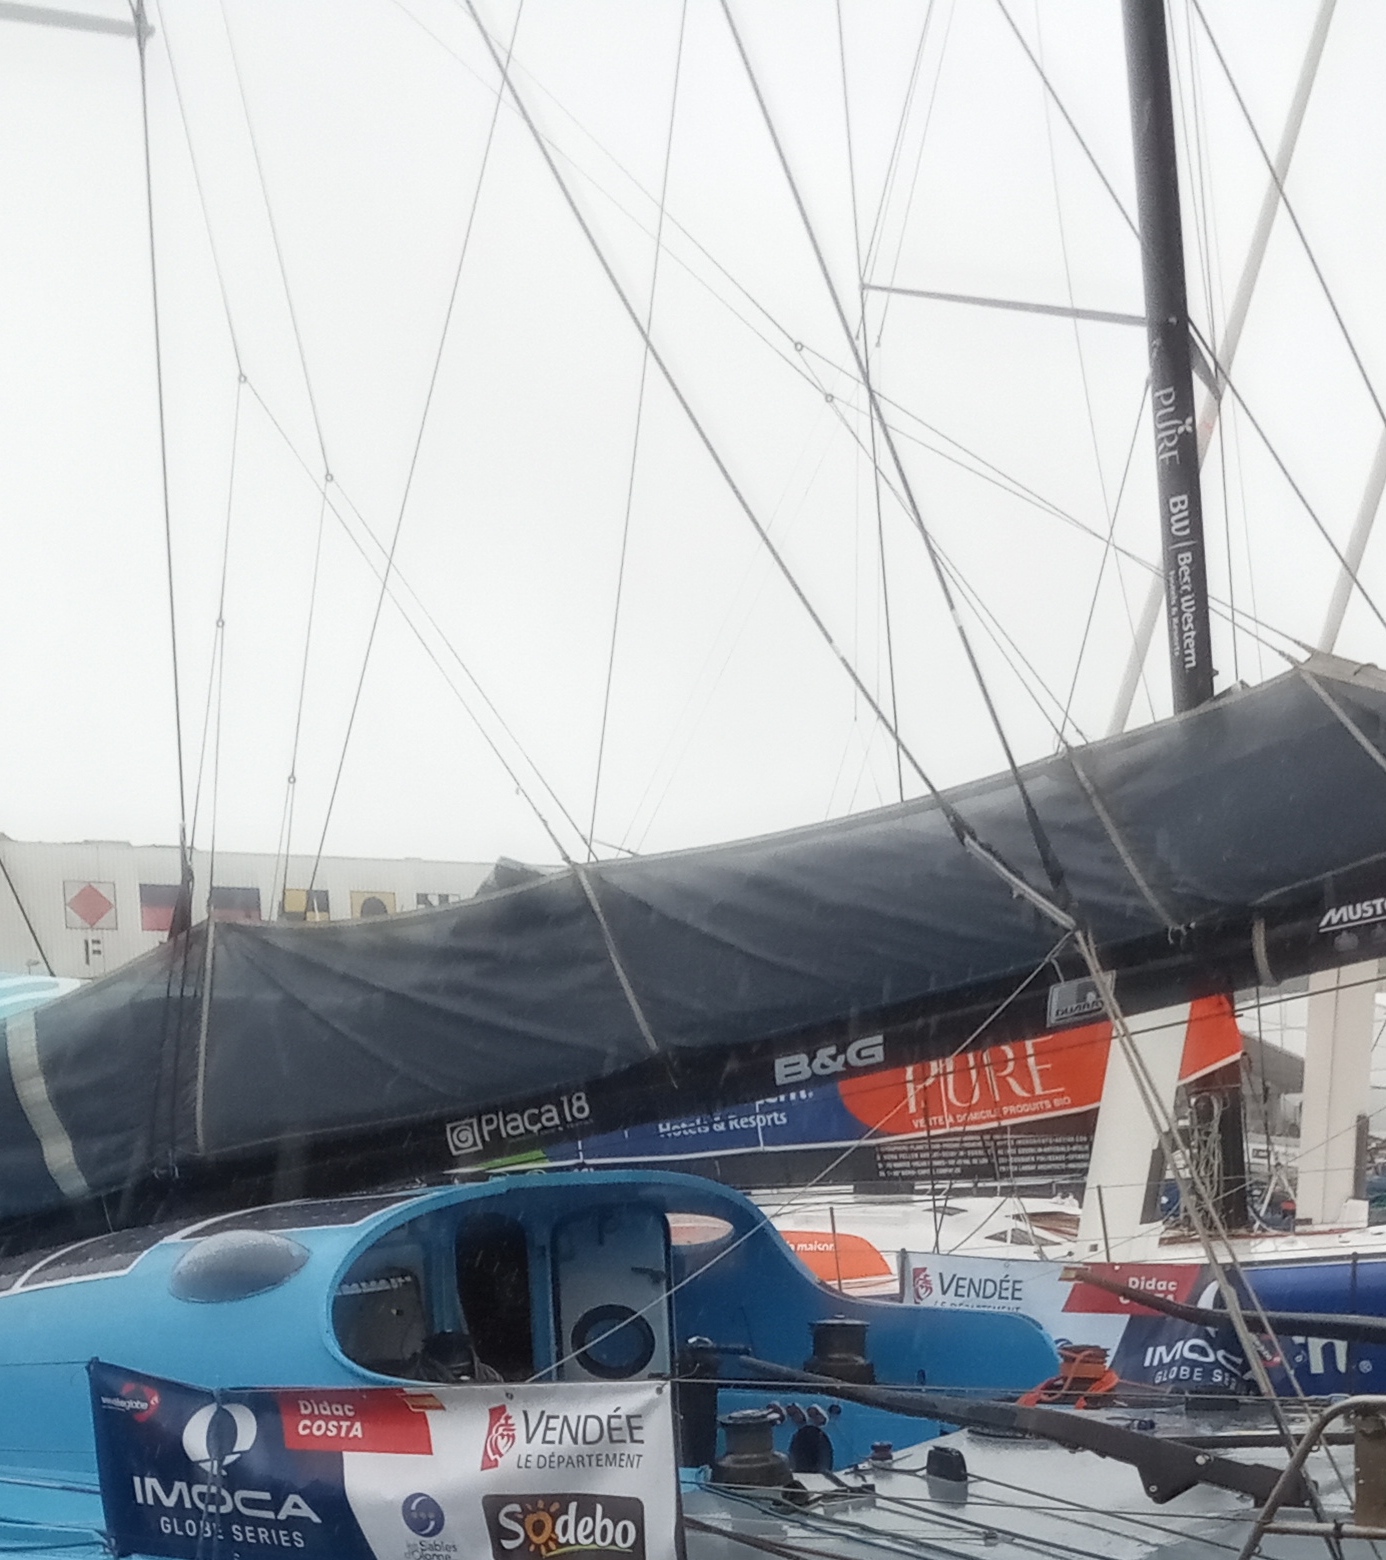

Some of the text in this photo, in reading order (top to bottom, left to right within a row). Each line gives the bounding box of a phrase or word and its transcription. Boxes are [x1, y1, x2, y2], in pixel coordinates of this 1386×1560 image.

[1154, 386, 1180, 464] PURE
[1169, 494, 1190, 536] BW
[775, 1035, 884, 1086] B&G
[938, 1271, 1023, 1301] VENDÉE
[1128, 1276, 1178, 1291] Didac
[1154, 1366, 1203, 1385] GLOBE
[298, 1399, 355, 1417] Didac
[298, 1419, 363, 1438] COSTA
[522, 1407, 645, 1446] VENDÉE
[517, 1450, 643, 1470] LE DÉPARTEMENT
[133, 1476, 322, 1524] IMOCA
[232, 1524, 305, 1548] SERIES
[499, 1501, 637, 1551] Sodebo
